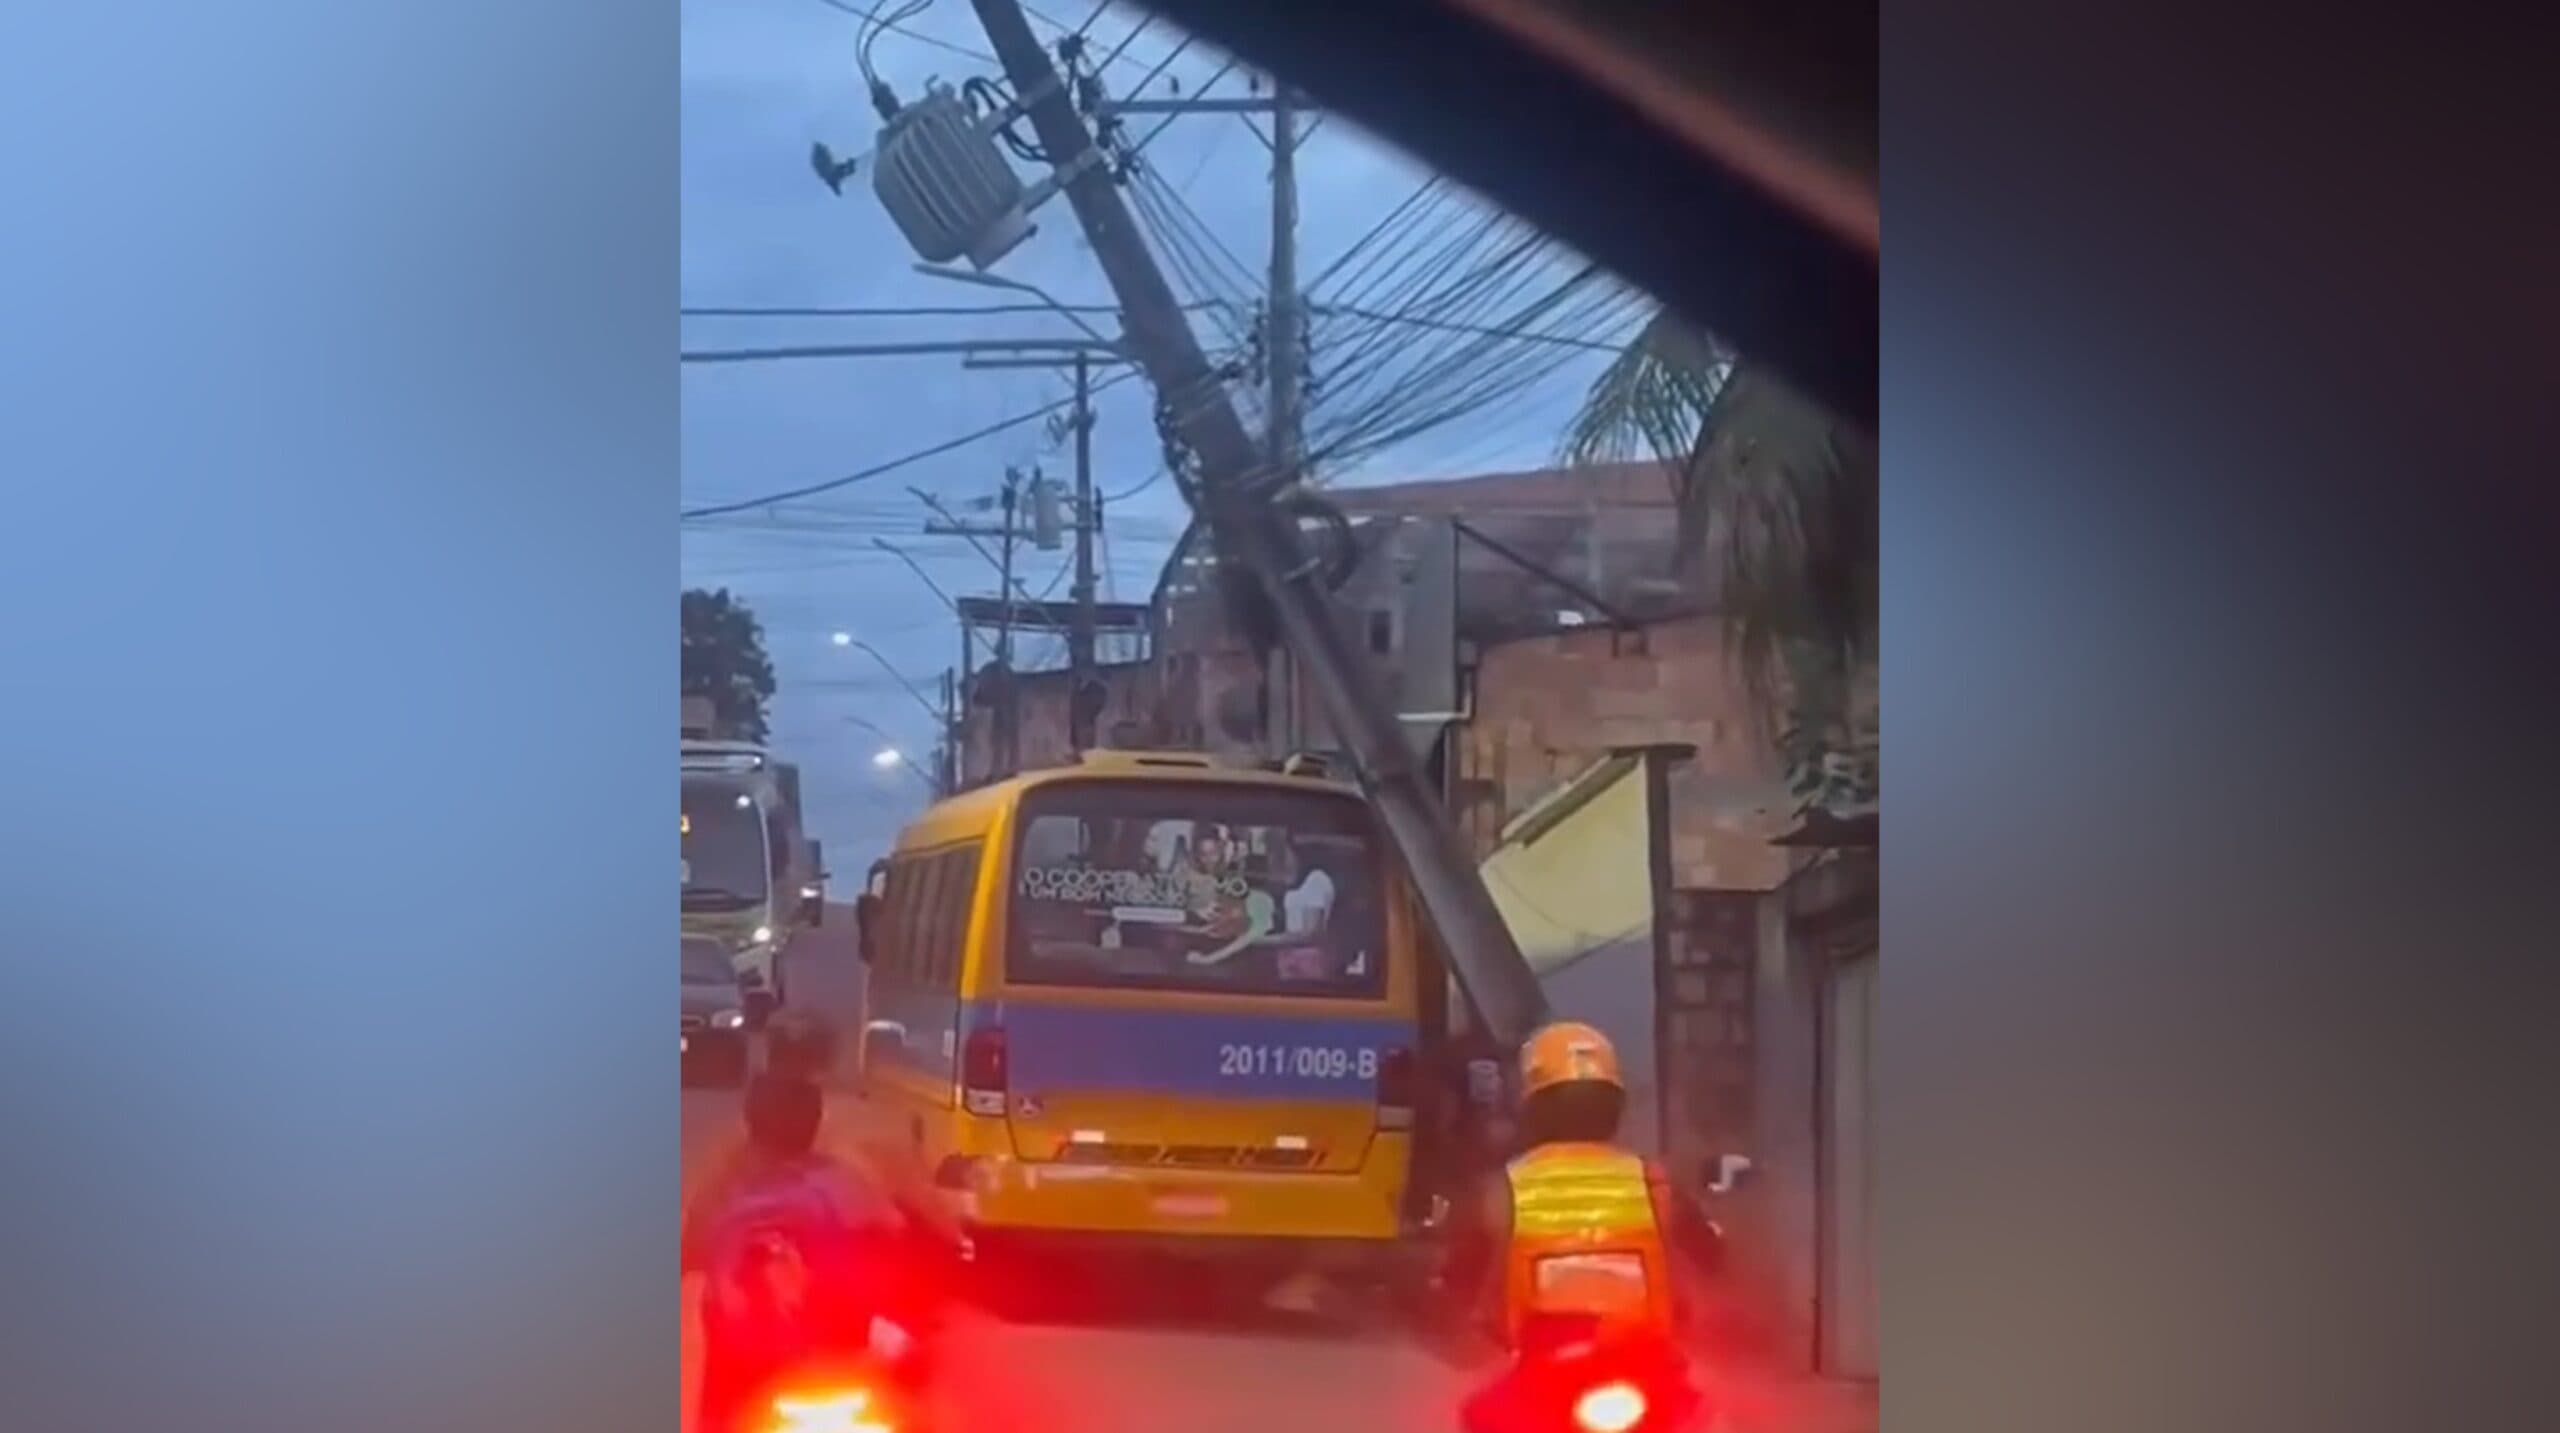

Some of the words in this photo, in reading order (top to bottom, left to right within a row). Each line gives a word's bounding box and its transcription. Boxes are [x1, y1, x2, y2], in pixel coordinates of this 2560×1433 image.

[1025, 867, 1043, 886] O
[1047, 868, 1248, 897] COOPERATIVMO
[1219, 1044, 1377, 1079] 2011/009-B
